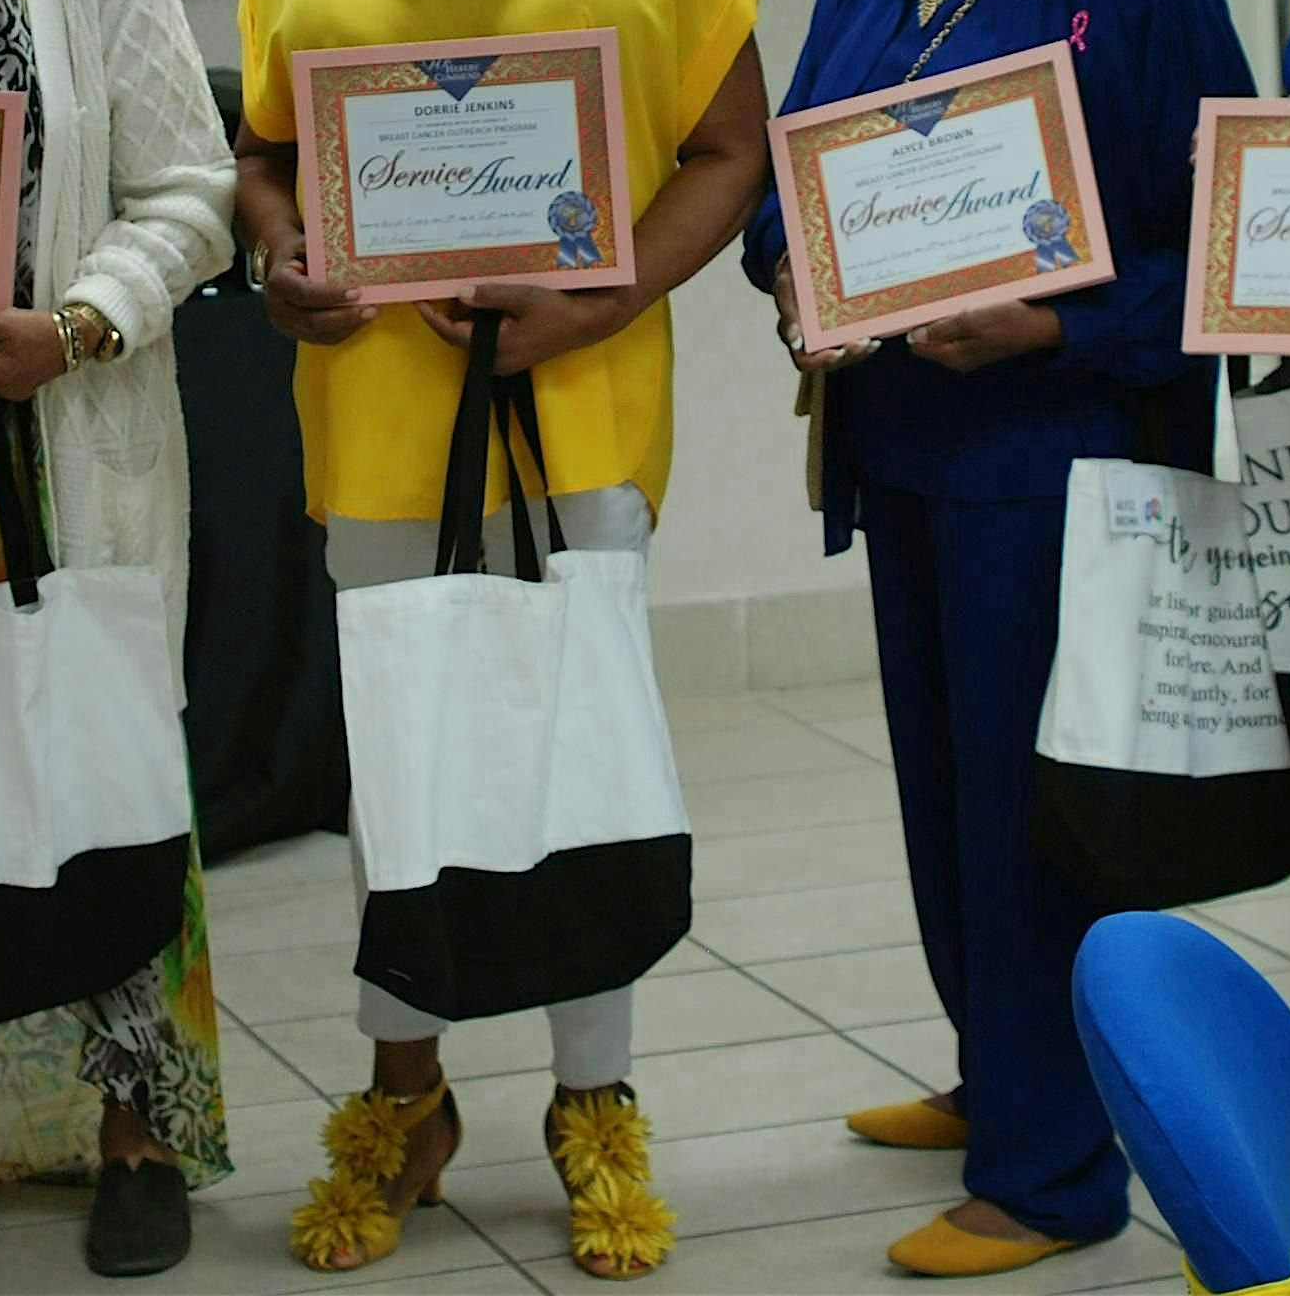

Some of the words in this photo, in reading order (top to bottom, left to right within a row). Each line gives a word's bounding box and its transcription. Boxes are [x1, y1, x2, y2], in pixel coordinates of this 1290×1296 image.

[414, 103, 461, 117] DORRIE
[464, 98, 516, 113] JENKINS
[379, 131, 410, 142] BREAST
[411, 129, 445, 140] CANCER
[446, 125, 492, 137] OUTREACH
[493, 122, 537, 134] PROGRAM
[892, 141, 925, 157] ALYCE
[928, 127, 974, 147] BROWN
[358, 149, 474, 199] Service
[444, 156, 573, 197] Award
[840, 190, 947, 242] Service
[920, 170, 1041, 225] Award
[1222, 656, 1262, 675] And
[1243, 682, 1272, 702] for
[1196, 715, 1222, 733] my
